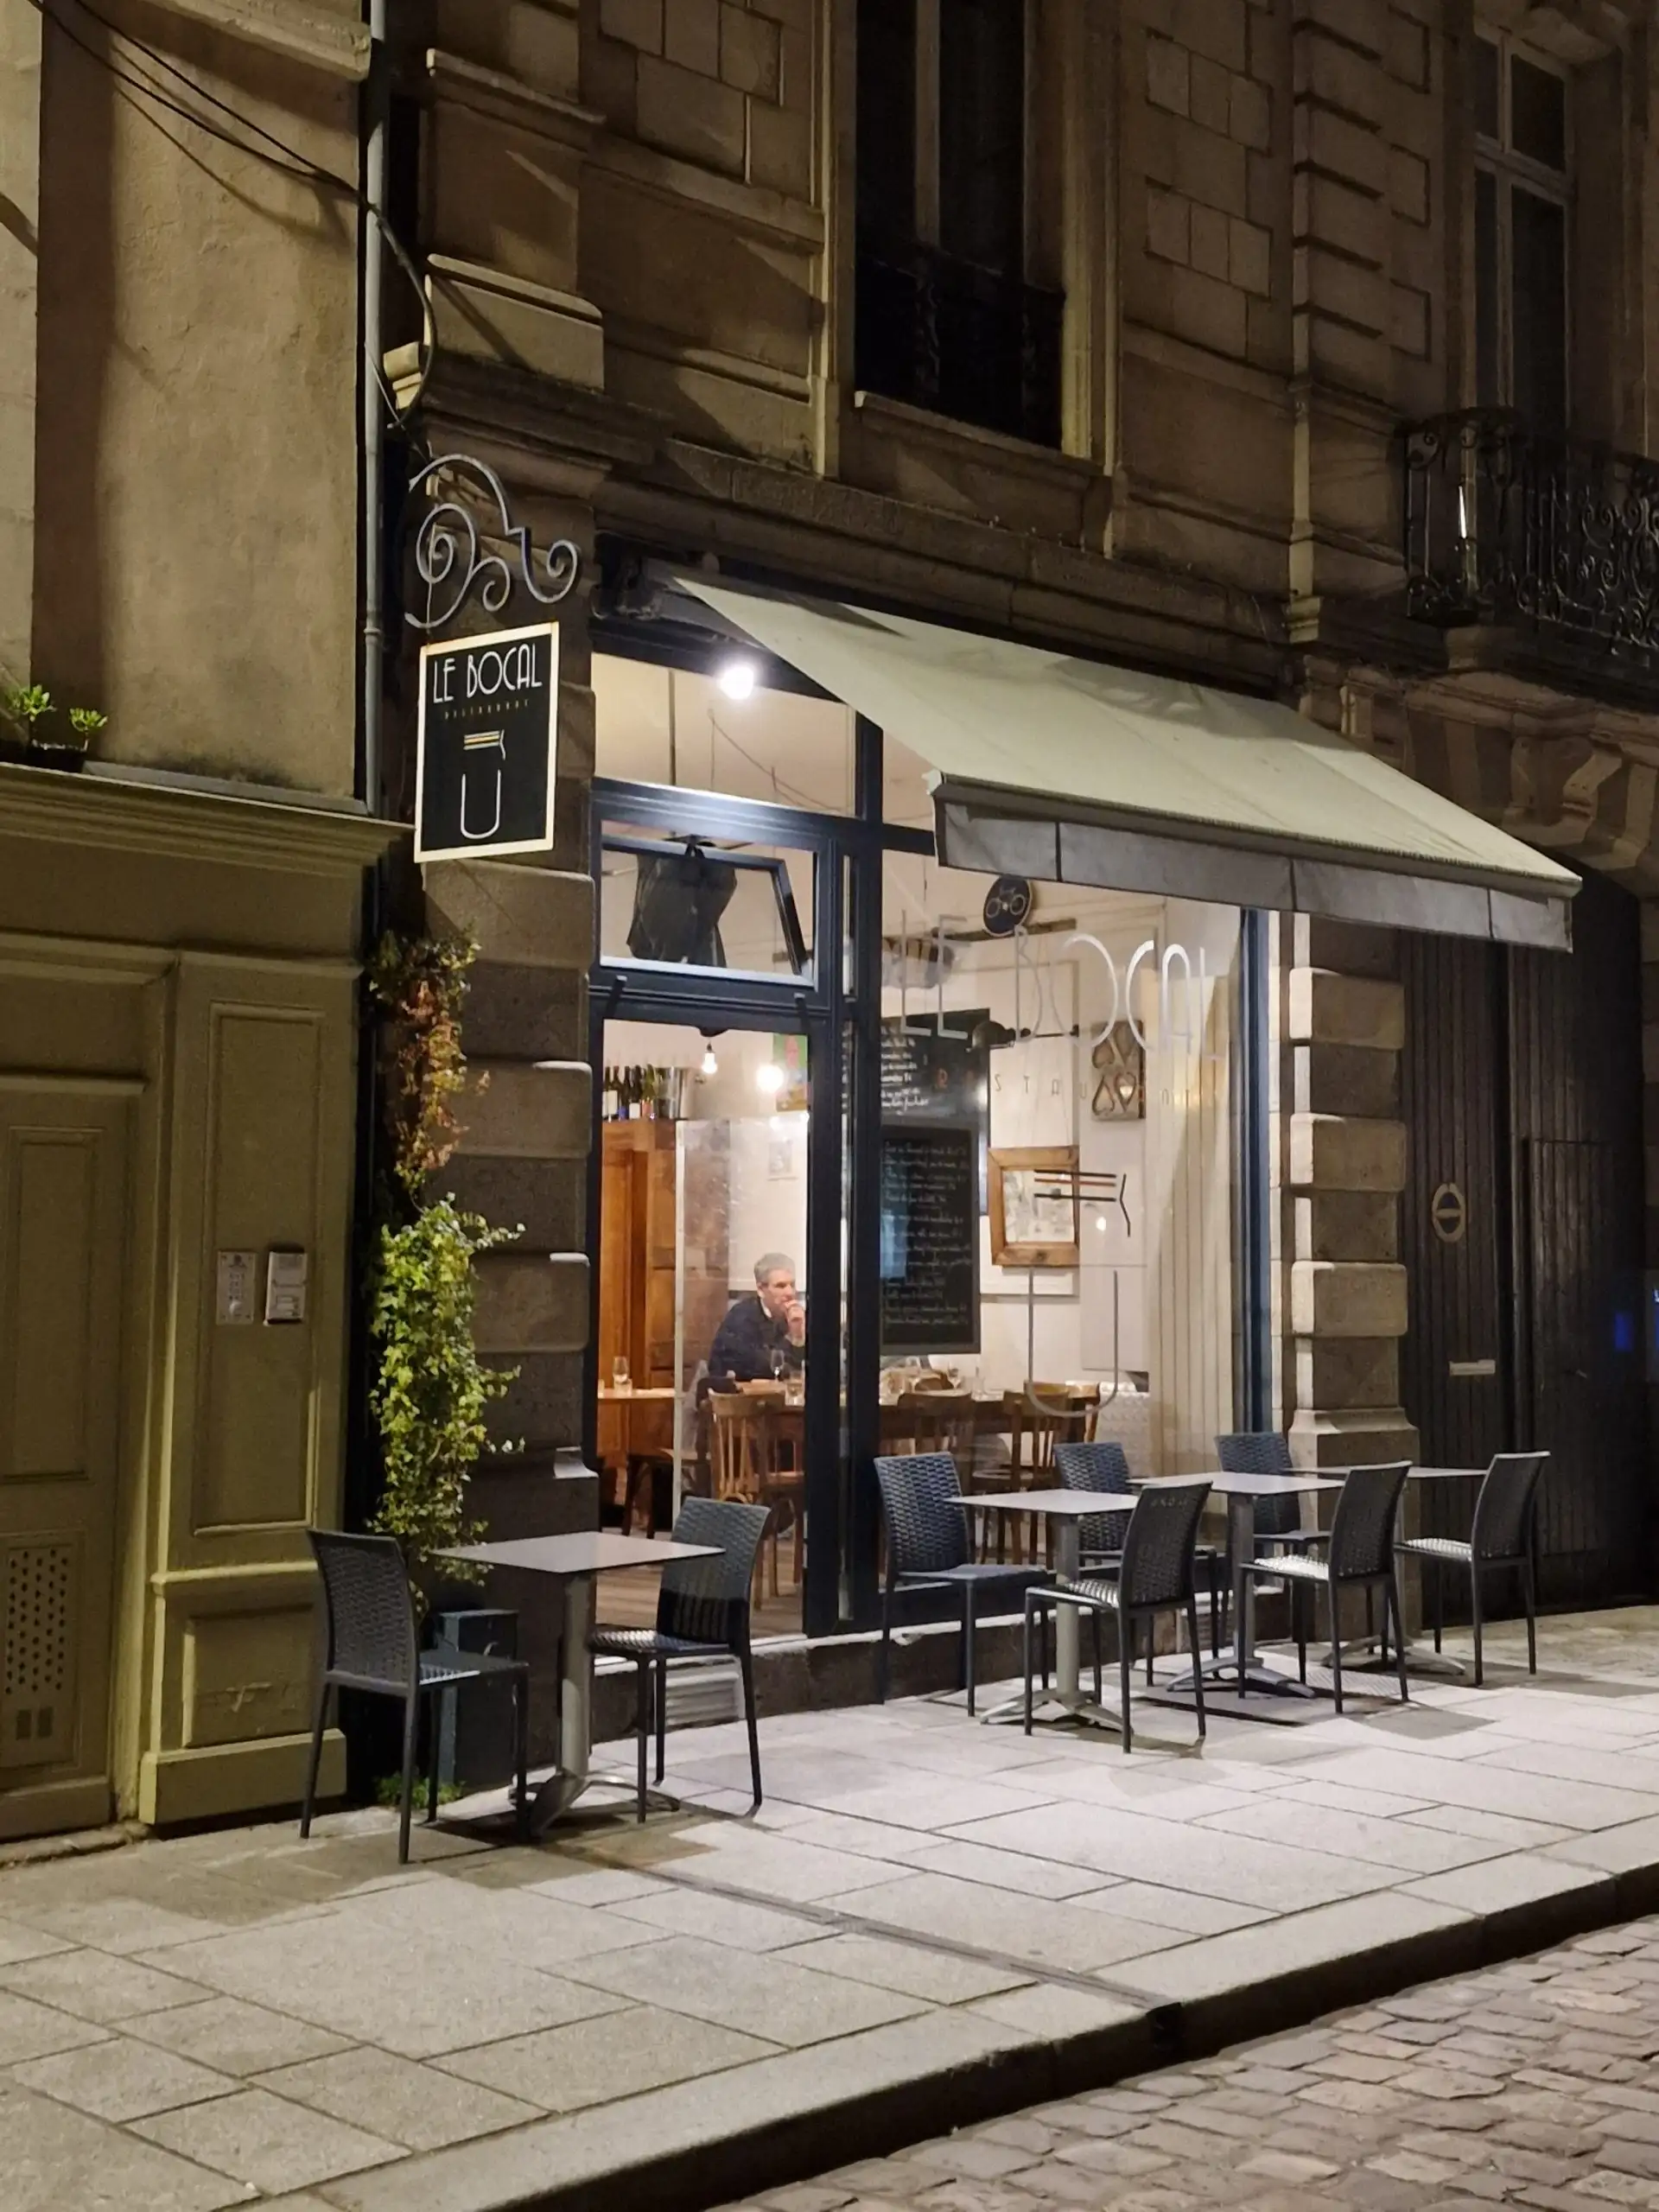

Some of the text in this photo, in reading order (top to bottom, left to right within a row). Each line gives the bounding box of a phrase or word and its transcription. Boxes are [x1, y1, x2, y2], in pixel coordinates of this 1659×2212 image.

[433, 643, 543, 704] LE BOCAL
[900, 908, 1221, 1059] LE BOCAL
